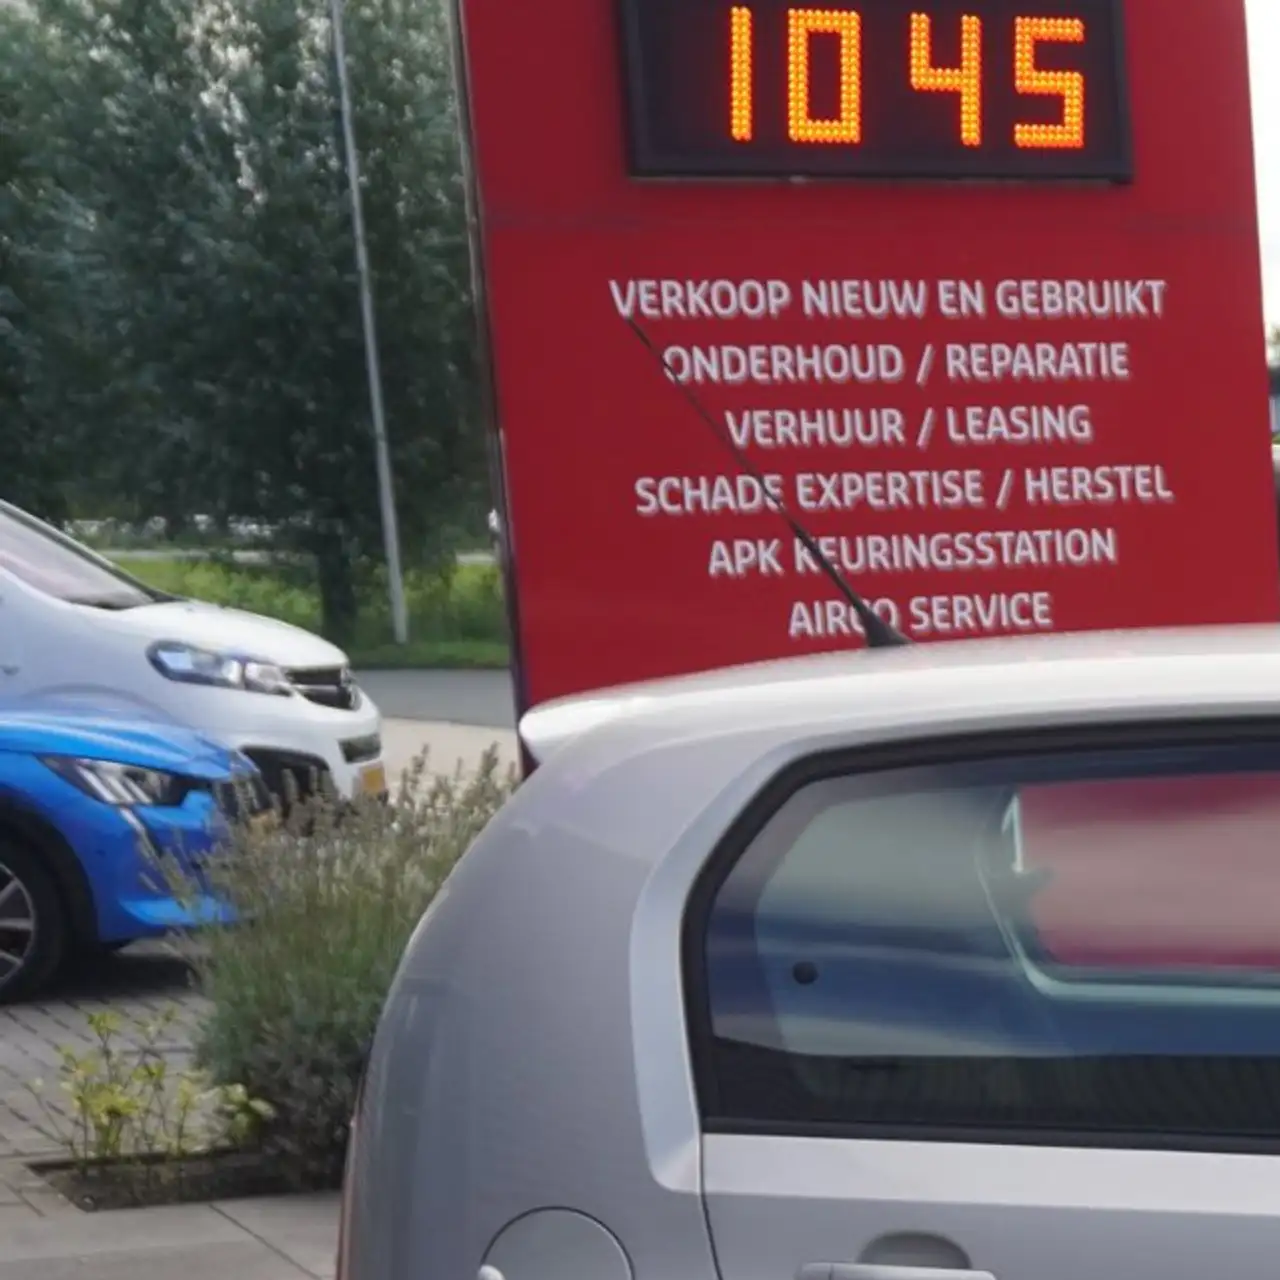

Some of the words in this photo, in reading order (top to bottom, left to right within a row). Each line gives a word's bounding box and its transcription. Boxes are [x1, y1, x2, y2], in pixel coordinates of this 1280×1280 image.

[609, 279, 791, 318] VERKOOP
[802, 279, 927, 317] NIEUW
[937, 279, 986, 317] EN
[995, 279, 1166, 317] GEBRUIKT
[662, 344, 904, 383] ONDERHOUD
[916, 343, 933, 384] /
[946, 342, 1130, 380] REPARATIE
[724, 407, 905, 447] VERHUUR
[917, 407, 933, 447] /
[946, 404, 1093, 443] LEASING
[634, 474, 783, 514] SCHADE
[796, 469, 985, 510] EXPERTISE
[995, 468, 1012, 509] /
[1025, 465, 1173, 504] HERSTEL
[708, 538, 783, 576] APK
[793, 527, 1117, 573] KEURINGSSTATION
[909, 591, 1053, 633] SERVICE
